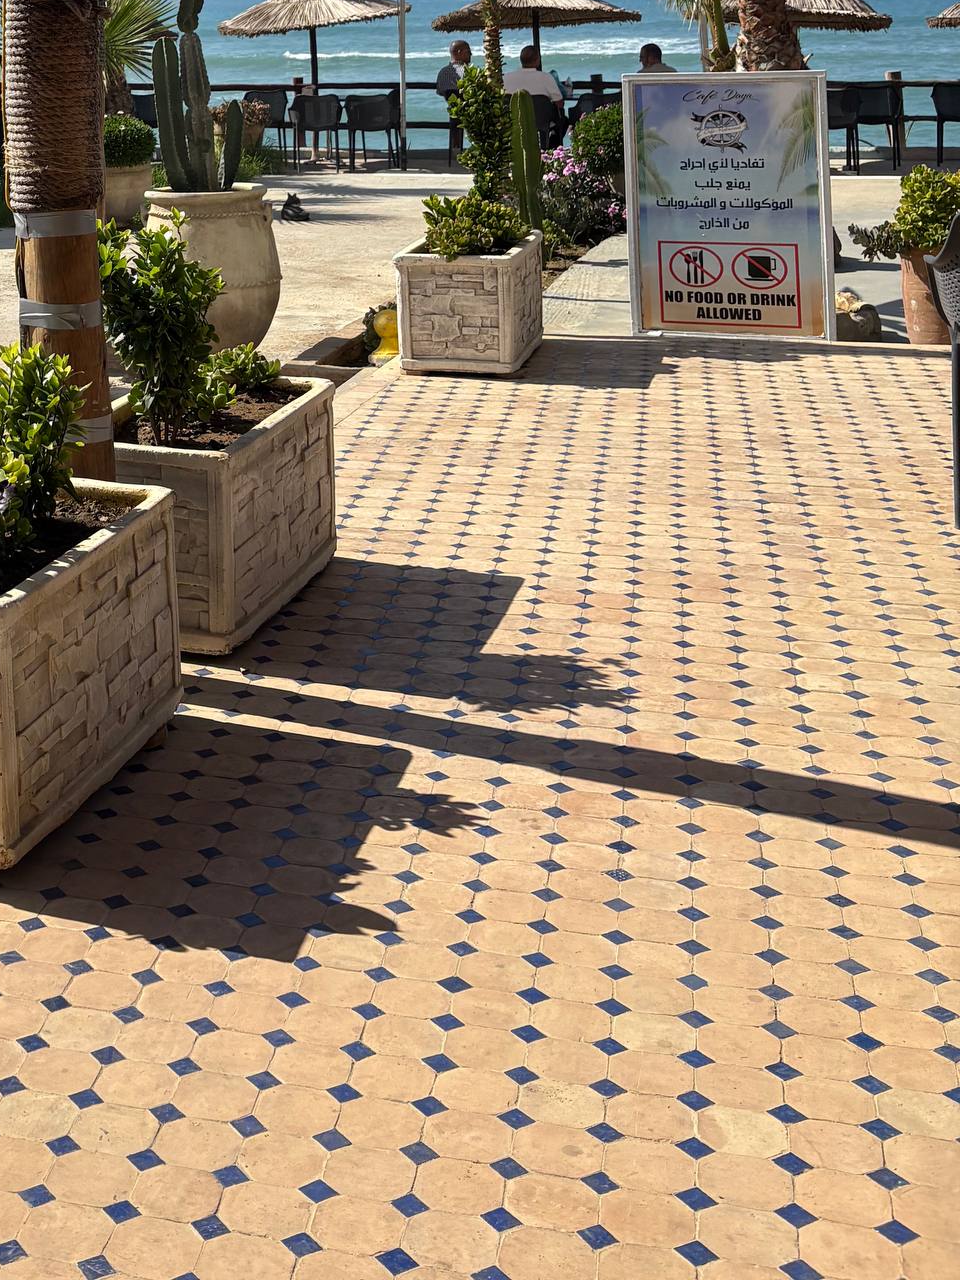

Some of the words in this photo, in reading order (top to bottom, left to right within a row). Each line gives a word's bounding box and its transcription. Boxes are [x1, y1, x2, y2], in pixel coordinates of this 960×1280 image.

[731, 158, 765, 171] تفاديا
[695, 178, 722, 191] جلب
[726, 178, 751, 191] يمنع
[656, 196, 717, 210] المشروبات
[719, 200, 727, 210] و
[699, 217, 730, 230] الخارج
[732, 218, 749, 230] من
[664, 290, 684, 303] NO
[687, 291, 724, 305] FOOD
[727, 292, 747, 306] OR
[750, 293, 797, 307] DRINK
[696, 306, 762, 321] ALLOWED
